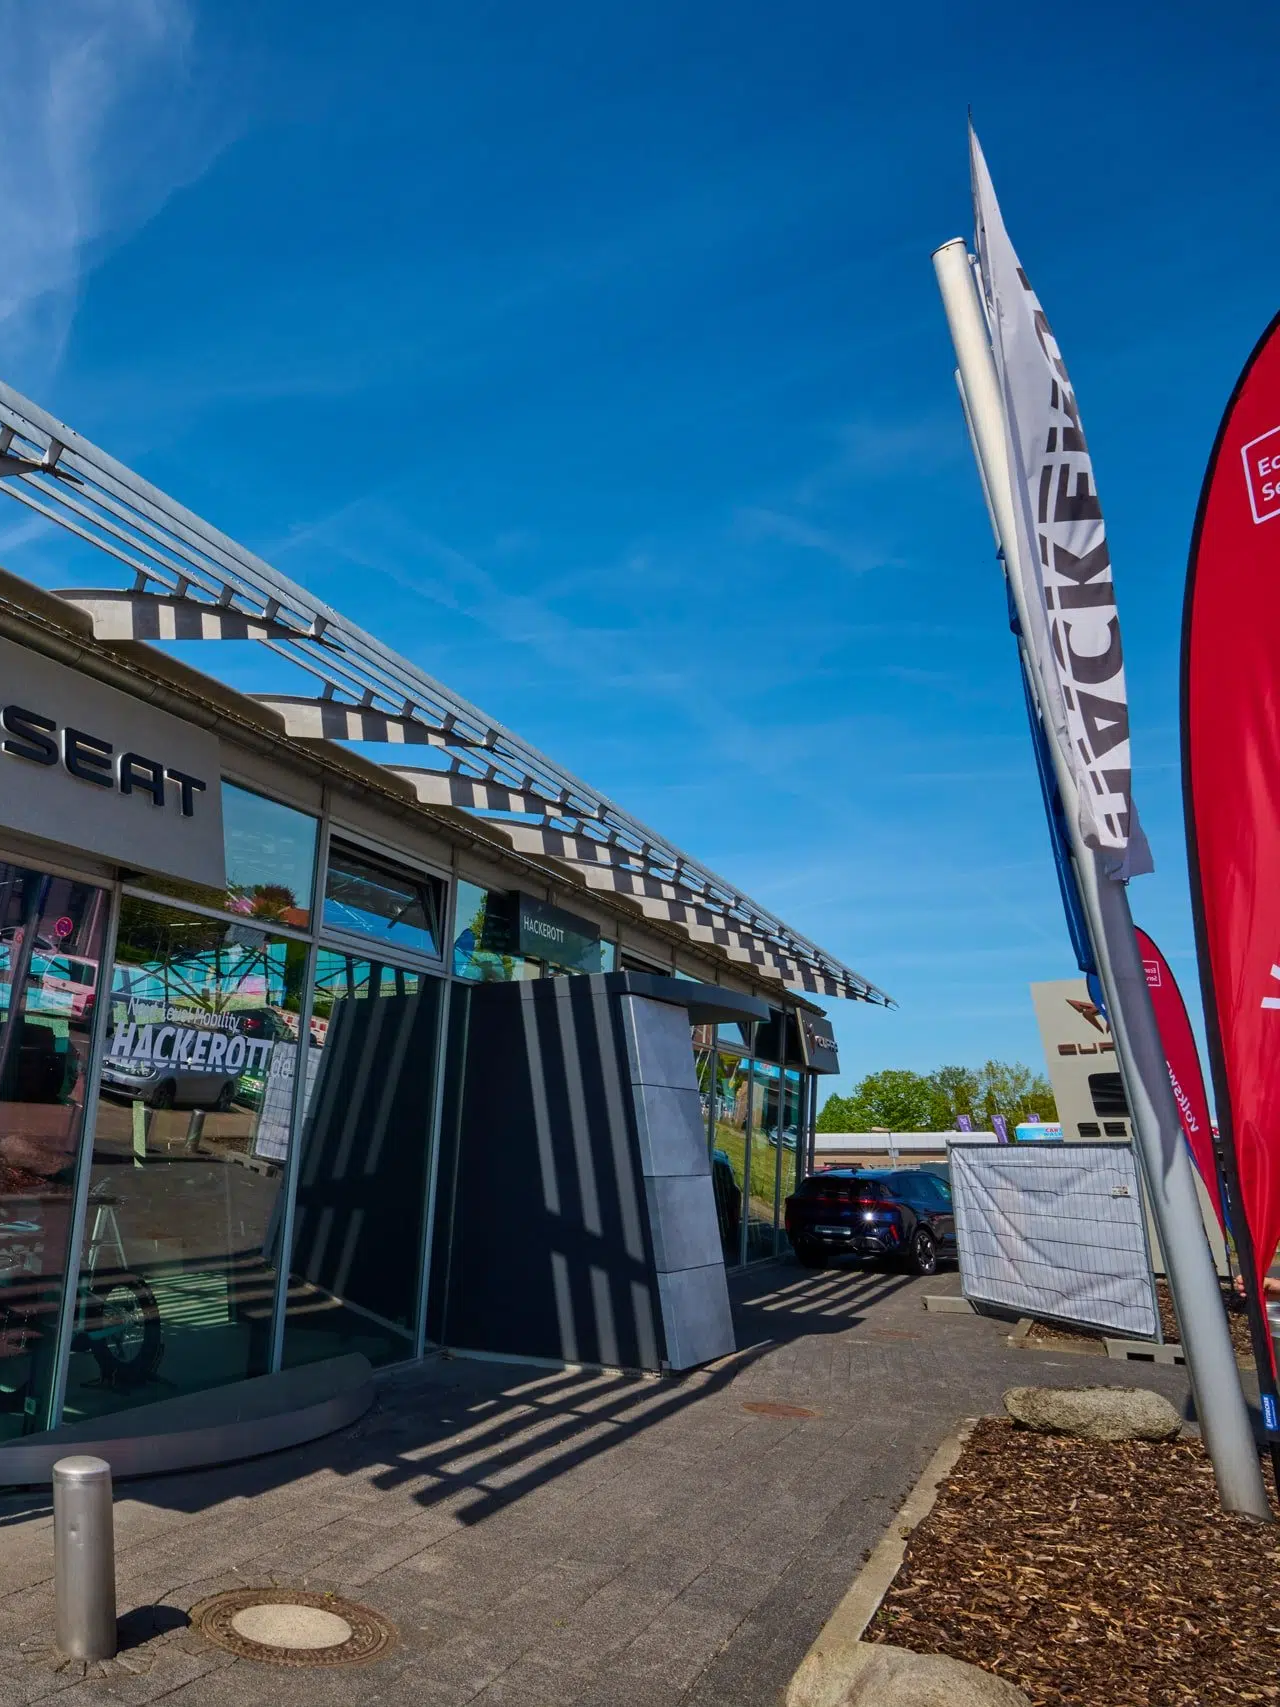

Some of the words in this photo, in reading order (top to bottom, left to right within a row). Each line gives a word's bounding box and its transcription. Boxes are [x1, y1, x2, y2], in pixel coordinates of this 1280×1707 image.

[1, 705, 206, 818] SEAT
[523, 915, 565, 944] HACKEROTT
[194, 1007, 240, 1034] Mobility
[1057, 1041, 1117, 1056] CUP
[1077, 1122, 1128, 1138] SE
